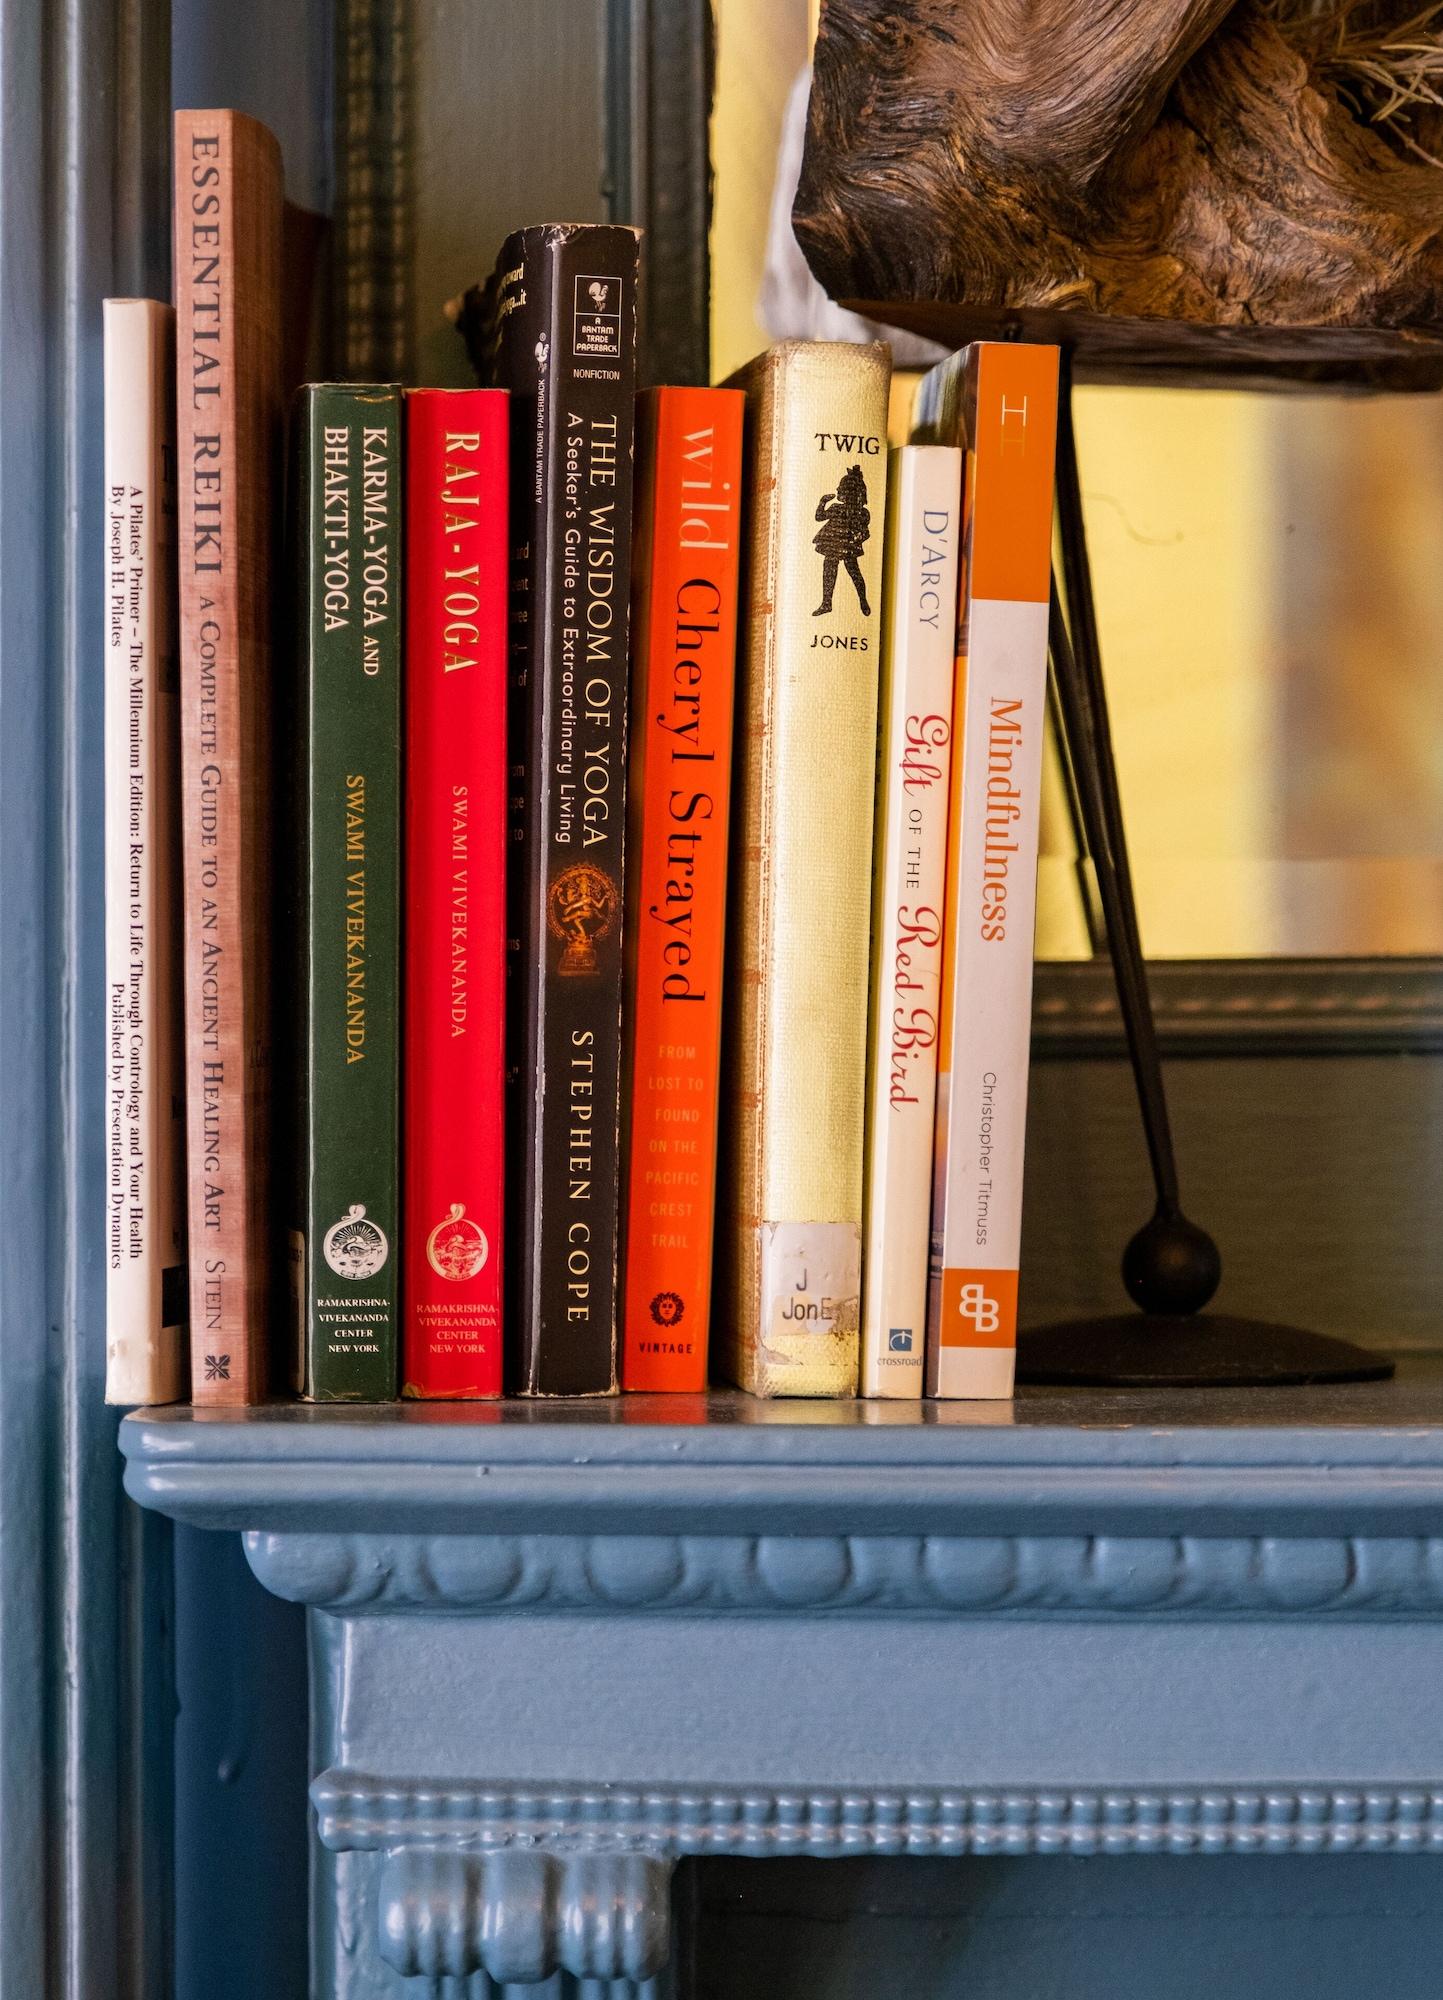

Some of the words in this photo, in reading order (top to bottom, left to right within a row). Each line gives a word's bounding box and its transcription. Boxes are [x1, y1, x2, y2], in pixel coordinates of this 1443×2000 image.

[192, 135, 221, 410] ESSENTIAL
[577, 343, 617, 352] PAPERBACK
[582, 326, 613, 334] BANTAM
[587, 335, 608, 343] TRADE
[574, 369, 619, 380] NONFICTION
[537, 379, 545, 428] PAPERBACK
[568, 413, 583, 427] A
[590, 415, 617, 486] THE
[815, 434, 880, 455] TWIG
[108, 487, 124, 507] By
[131, 488, 143, 497] A
[566, 437, 583, 518] Seeker's
[680, 428, 730, 549] wild
[193, 432, 224, 575] REIKI
[364, 427, 387, 627] KARMA-YOGA
[111, 512, 124, 564] Joseph
[131, 505, 143, 560] Pilates'
[324, 426, 349, 632] BHAKTI-YOGA
[112, 572, 124, 588] H.
[565, 529, 580, 588] Guide
[586, 502, 614, 662] WISDOM
[920, 510, 948, 631] D'ARCY
[131, 568, 143, 622] Primer
[564, 598, 575, 618] to
[112, 596, 124, 646] Pilates
[811, 635, 868, 651] JONES
[131, 642, 143, 672] The
[364, 636, 378, 675] AND
[656, 578, 720, 765] Cheryl
[130, 679, 143, 767] Millennium
[557, 629, 578, 773] Extraordinary
[586, 679, 611, 727] OF
[899, 715, 950, 797] Gift
[131, 776, 143, 836] Edition:
[347, 776, 364, 861] SWAMI
[555, 785, 576, 842] Living
[583, 742, 609, 848] YOGA
[981, 697, 1023, 942] Mindfulness
[453, 786, 467, 859] SWAMI
[909, 810, 922, 834] OF
[131, 845, 143, 897] Return
[907, 847, 920, 888] THE
[131, 904, 141, 918] to
[650, 791, 713, 1004] Strayed
[131, 926, 143, 954] Life
[452, 870, 467, 1037] VIVEKANANDA
[894, 906, 941, 1000] Red
[347, 871, 365, 1064] VIVEKANANDA
[128, 961, 143, 1027] Through
[112, 984, 124, 1055] Published
[107, 1063, 124, 1085] by
[128, 1035, 143, 1117] Contrology
[659, 1046, 695, 1059] FROM
[890, 1007, 937, 1113] Bird
[649, 1077, 680, 1090] LOST
[688, 1078, 704, 1091] TO
[112, 1090, 124, 1186] Presentation
[570, 1031, 593, 1199] STEPHEN
[656, 1109, 699, 1122] FOUND
[979, 1072, 997, 1174] Christopher
[130, 1128, 143, 1155] and
[650, 1140, 667, 1153] ON
[674, 1140, 697, 1153] THE
[130, 1163, 143, 1201] Your
[646, 1171, 698, 1186] PACIFIC
[112, 1194, 124, 1268] Dynamics
[130, 1208, 143, 1258] Health
[650, 1203, 693, 1216] CREST
[975, 1179, 993, 1246] Titmuss
[652, 1235, 688, 1248] TRAIL
[568, 1223, 590, 1321] COPE
[796, 1269, 807, 1291] J
[317, 1298, 390, 1307] RAMAKRISHNA-
[319, 1314, 388, 1322] VIVEKANANDA
[419, 1317, 496, 1326] VIVEKANANDA
[430, 1345, 453, 1353] NEW
[457, 1344, 485, 1353] YORK
[437, 1331, 478, 1339] CENTER
[639, 1342, 692, 1354] VINTAGE
[877, 1355, 922, 1367] crossroad
